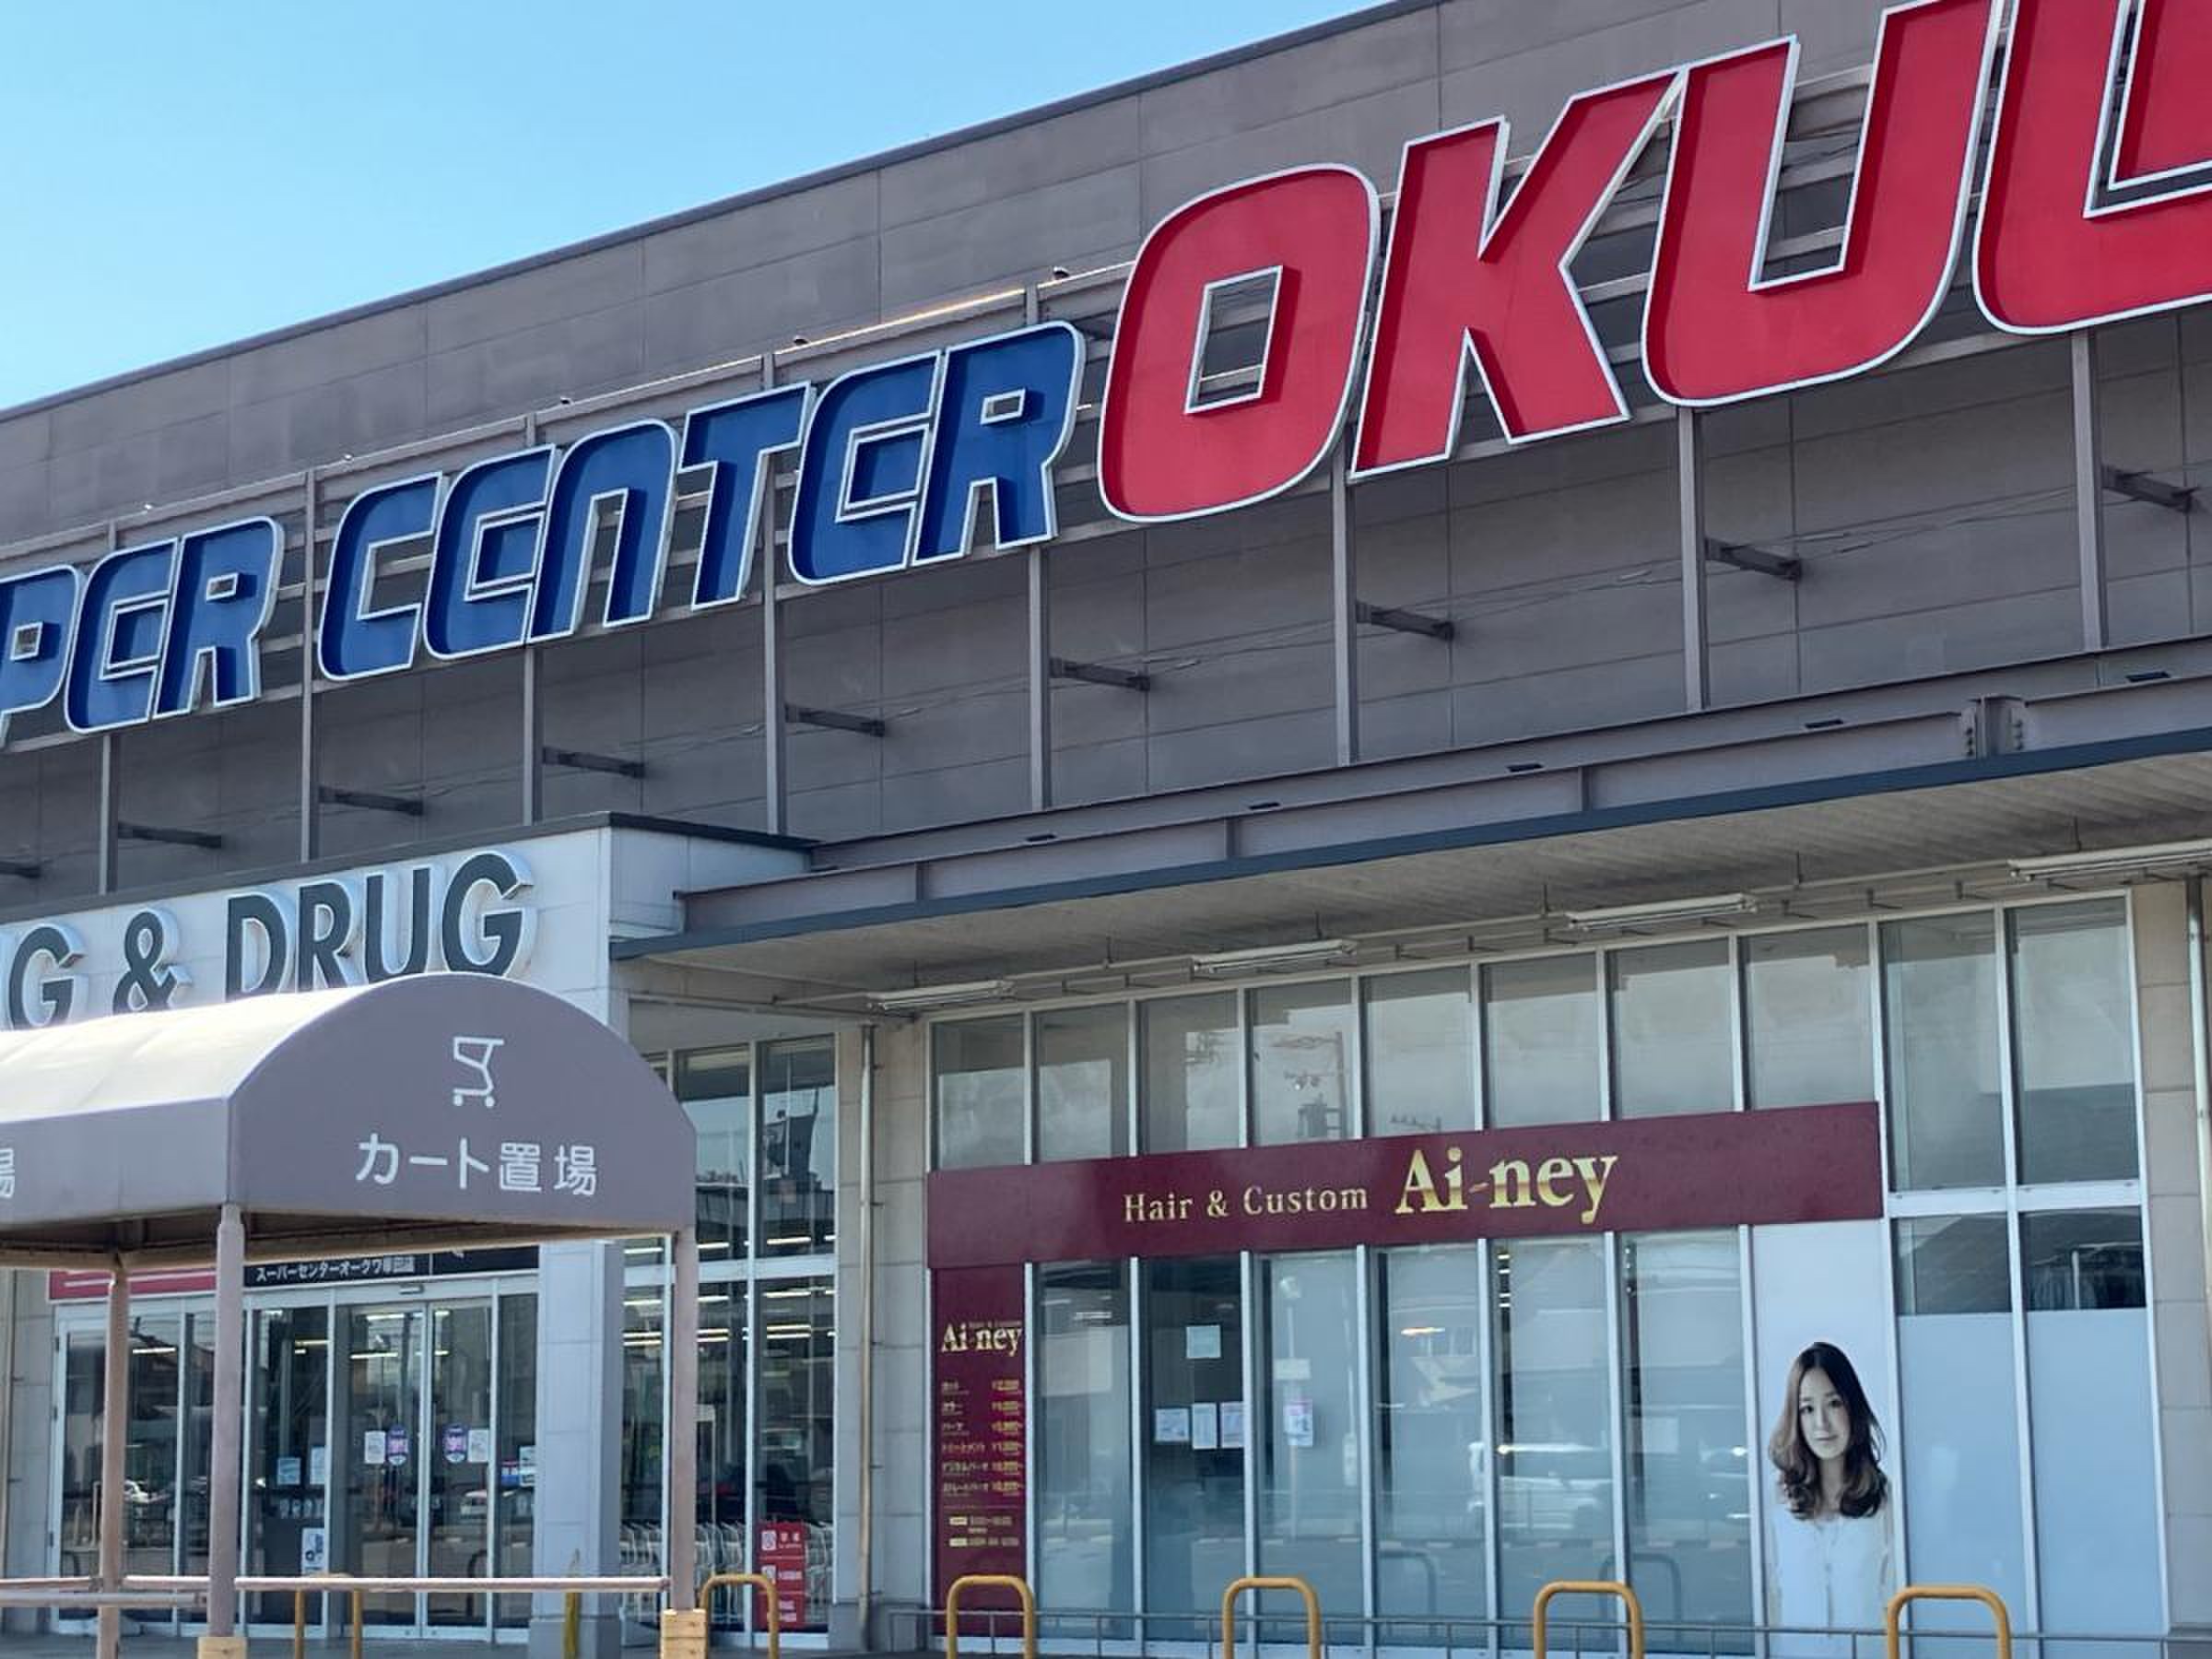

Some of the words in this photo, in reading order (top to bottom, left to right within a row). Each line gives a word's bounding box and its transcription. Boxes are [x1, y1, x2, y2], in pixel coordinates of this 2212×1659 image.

[318, 320, 1086, 681] CENTER
[112, 910, 184, 1013] &
[227, 852, 532, 1002] DRUG
[355, 1133, 597, 1197] カート置場
[1124, 1193, 1194, 1222] Hair
[1207, 1189, 1230, 1218] &
[1242, 1183, 1369, 1217] Custom
[1394, 1147, 1618, 1224] Ai-ney
